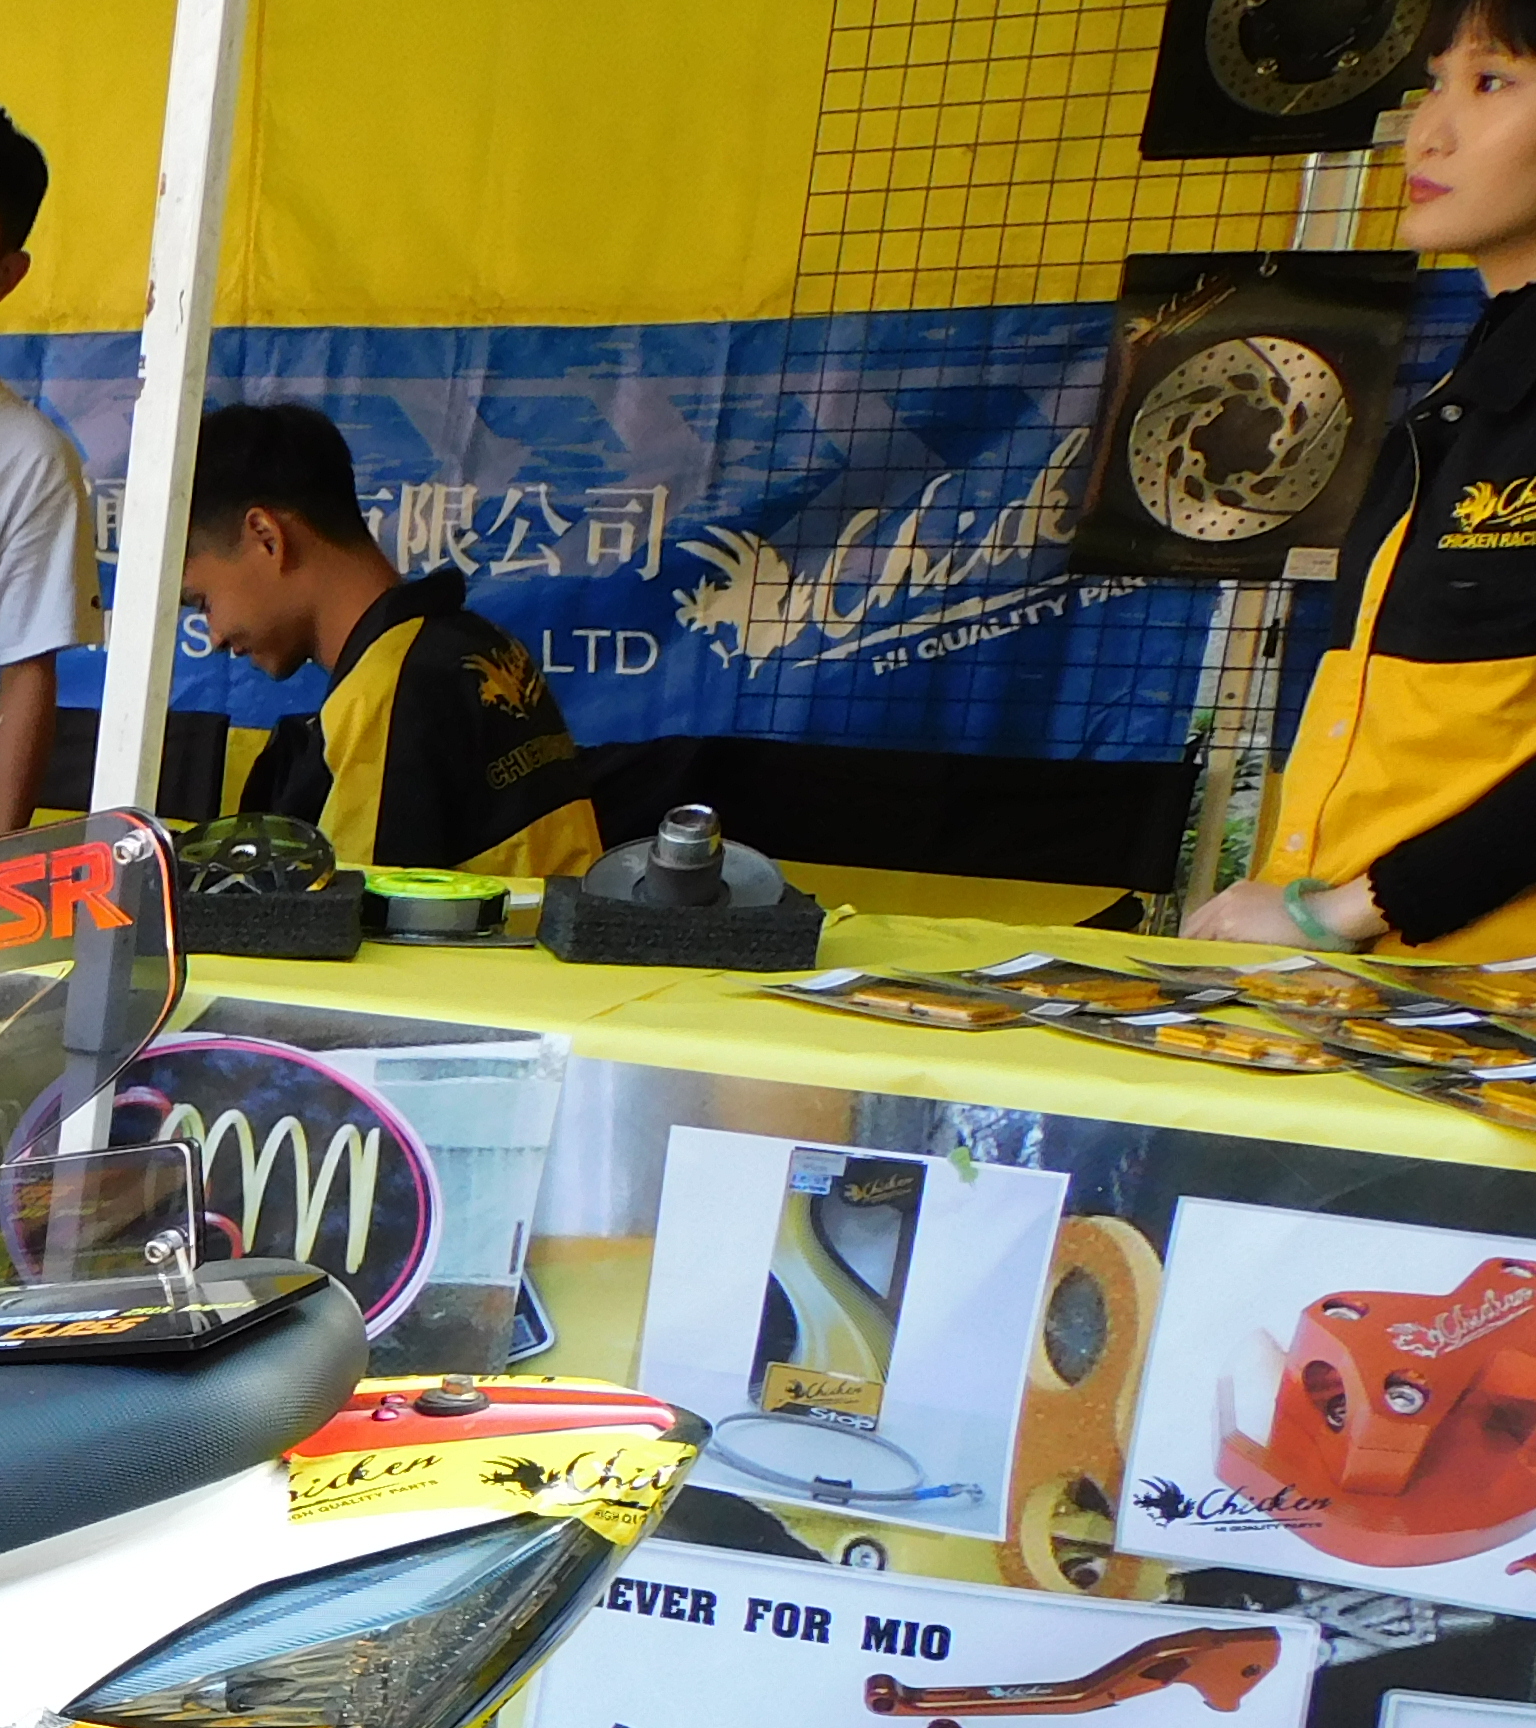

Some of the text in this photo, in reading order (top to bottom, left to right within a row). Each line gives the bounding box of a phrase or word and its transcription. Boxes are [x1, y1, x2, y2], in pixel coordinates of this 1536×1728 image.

[812, 427, 1090, 639] Chick
[541, 629, 659, 677] LTD
[872, 647, 908, 675] HI
[917, 594, 1067, 660] QUALITY
[317, 1493, 384, 1515] QUALITY
[389, 1479, 440, 1495] PARTS
[1196, 1484, 1332, 1521] Chicken
[743, 1597, 831, 1645] FOR
[861, 1616, 952, 1661] MIO
